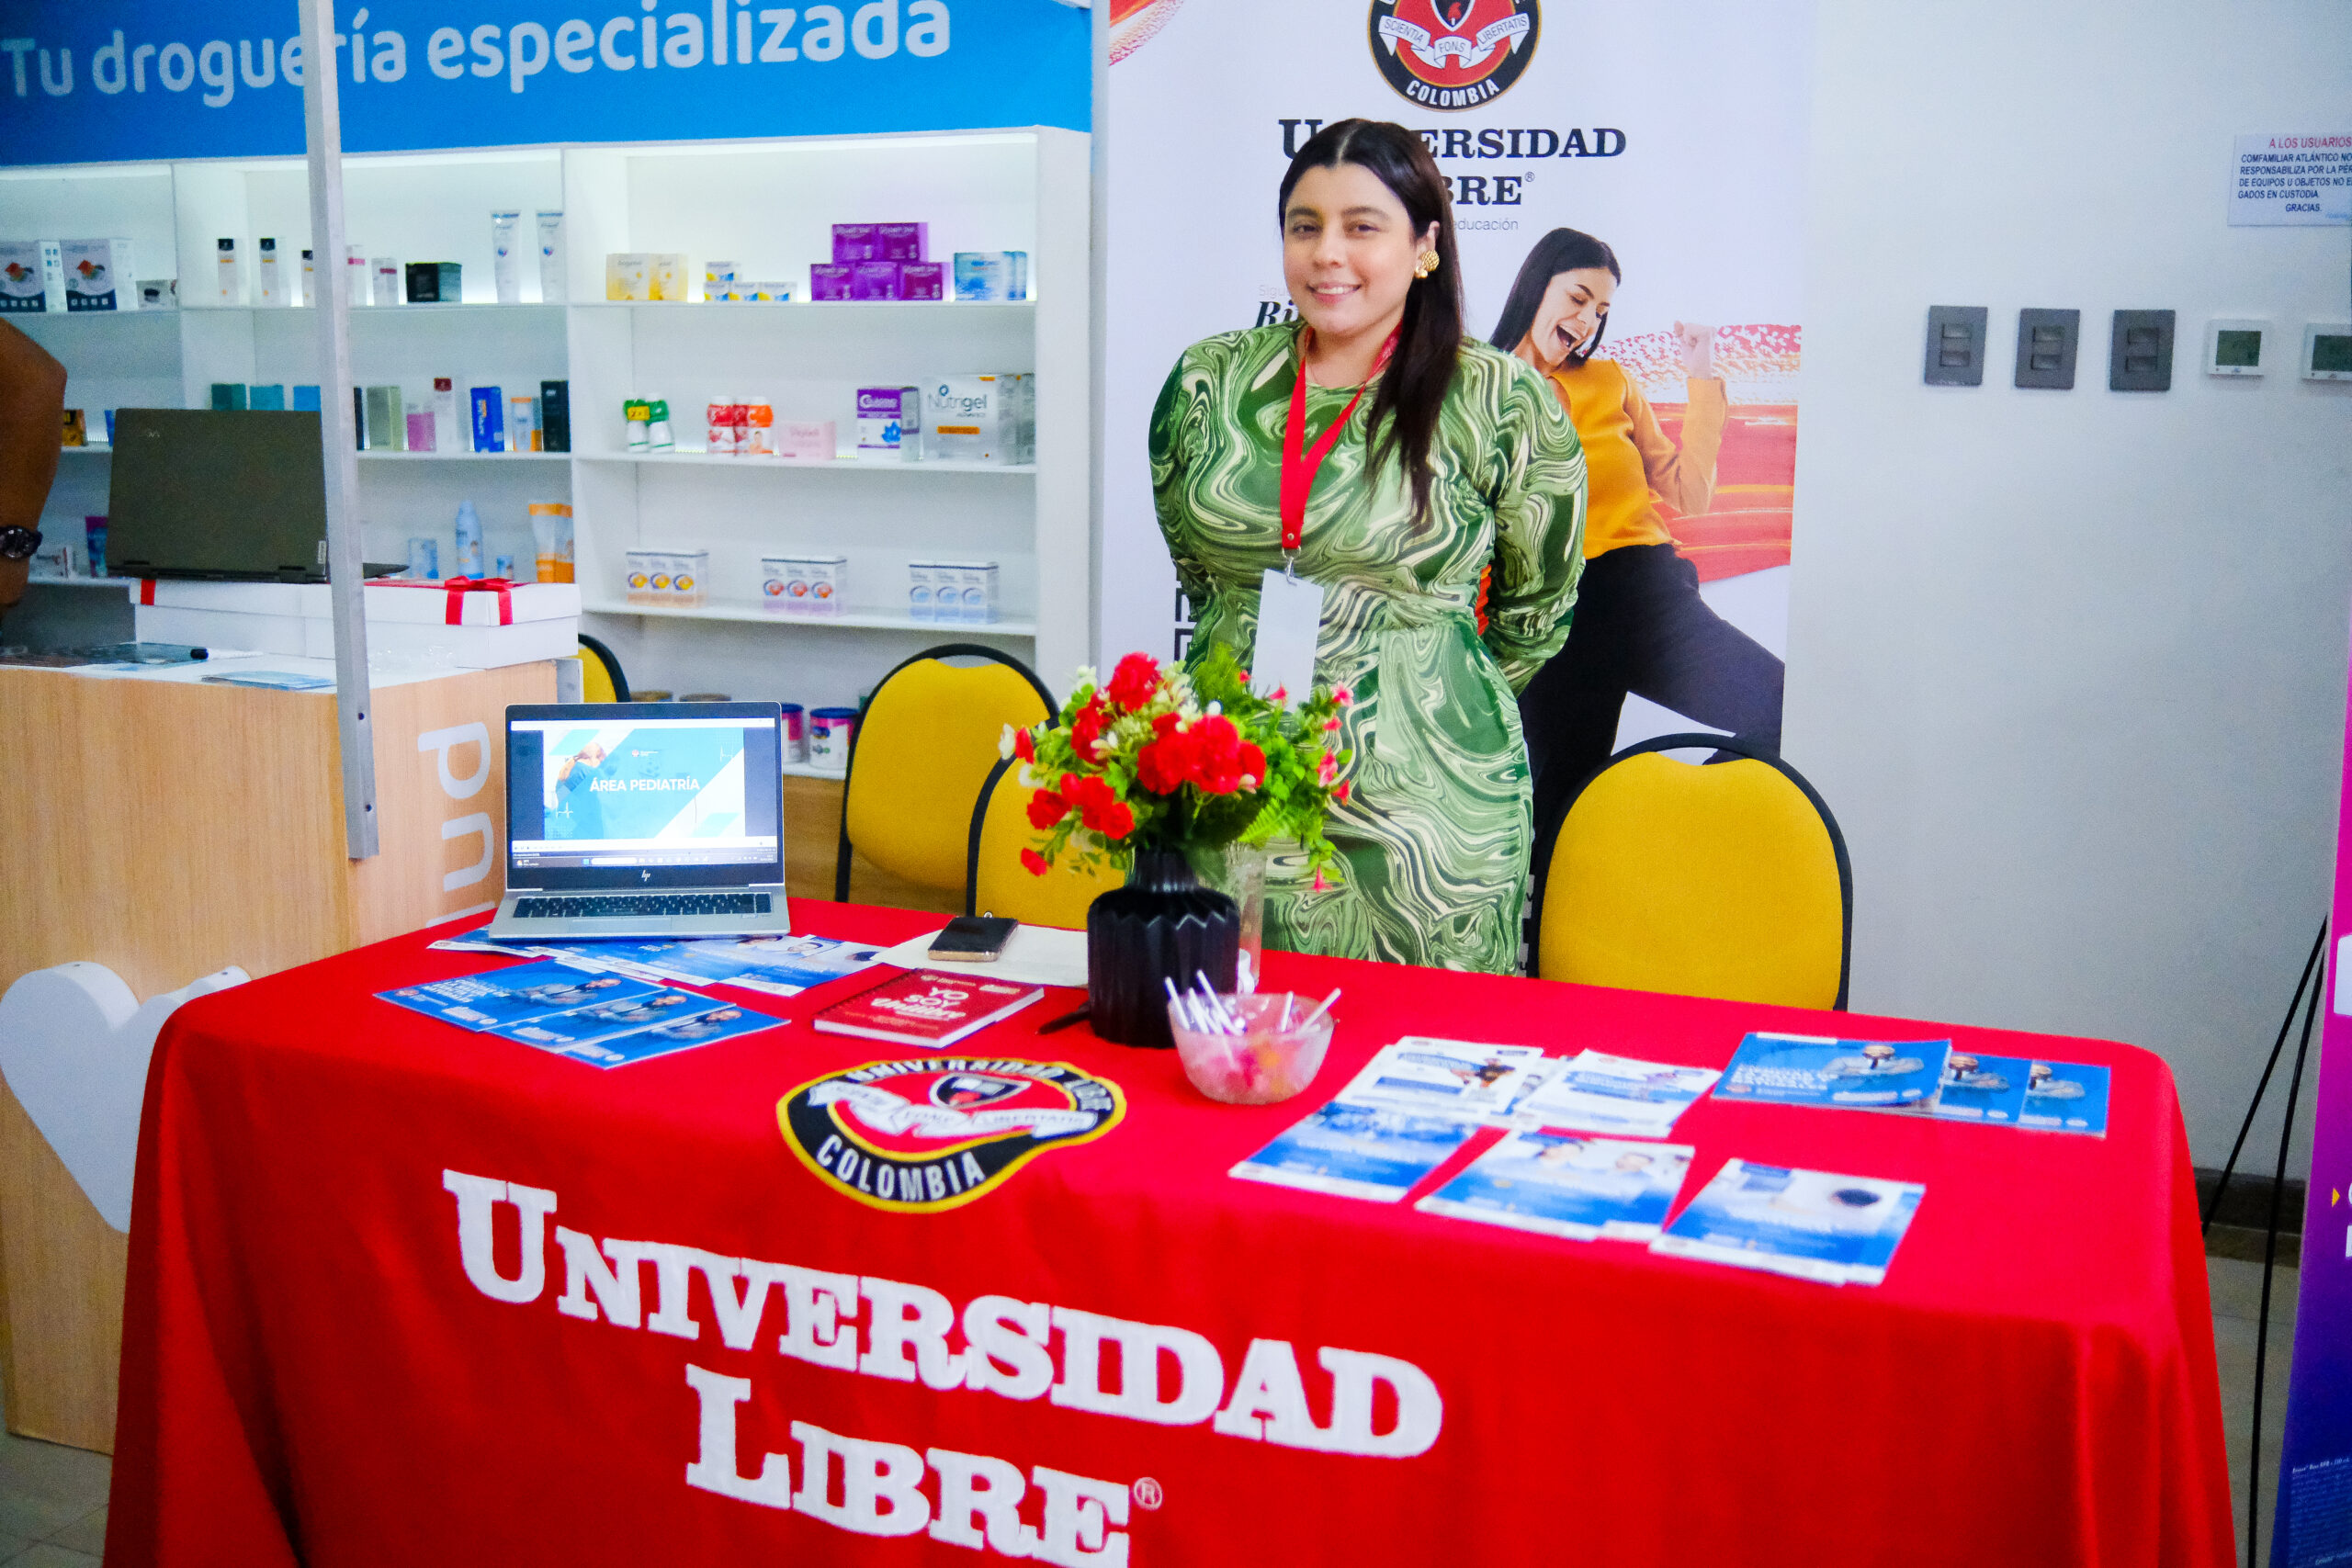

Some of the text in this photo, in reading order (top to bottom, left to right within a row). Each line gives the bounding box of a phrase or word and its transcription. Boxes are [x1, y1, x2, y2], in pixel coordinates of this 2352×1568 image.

[1384, 16, 1528, 53] SCIENTIA FONS LIBERTATIS
[1, 0, 950, 108] Tu drogueía especializada
[1406, 78, 1500, 107] COLOMBIA
[2268, 136, 2352, 149] A LOS USUARIOS
[2241, 153, 2293, 164] COMFAMILIAR
[2295, 151, 2339, 163] ATLÁNTICO
[2240, 165, 2306, 175] RESPONSABILIZA
[2307, 164, 2324, 175] POR
[2326, 165, 2336, 175] LA
[2239, 178, 2249, 187] DE
[2251, 177, 2285, 186] EQUIPOS
[2288, 177, 2293, 186] U
[2295, 176, 2331, 186] OBJETOS
[2333, 176, 2345, 186] NO
[2237, 189, 2266, 199] GADOS
[2267, 190, 2278, 199] EN
[2285, 203, 2323, 213] GRACIAS.
[927, 393, 988, 412] Nutrigel
[589, 775, 700, 792] ÁREA PEDIATRÍA
[929, 986, 969, 1000] YO
[903, 994, 961, 1008] SOY
[815, 1134, 987, 1202] COLOMBIA
[443, 1168, 1443, 1458] UNIVERSIDAD
